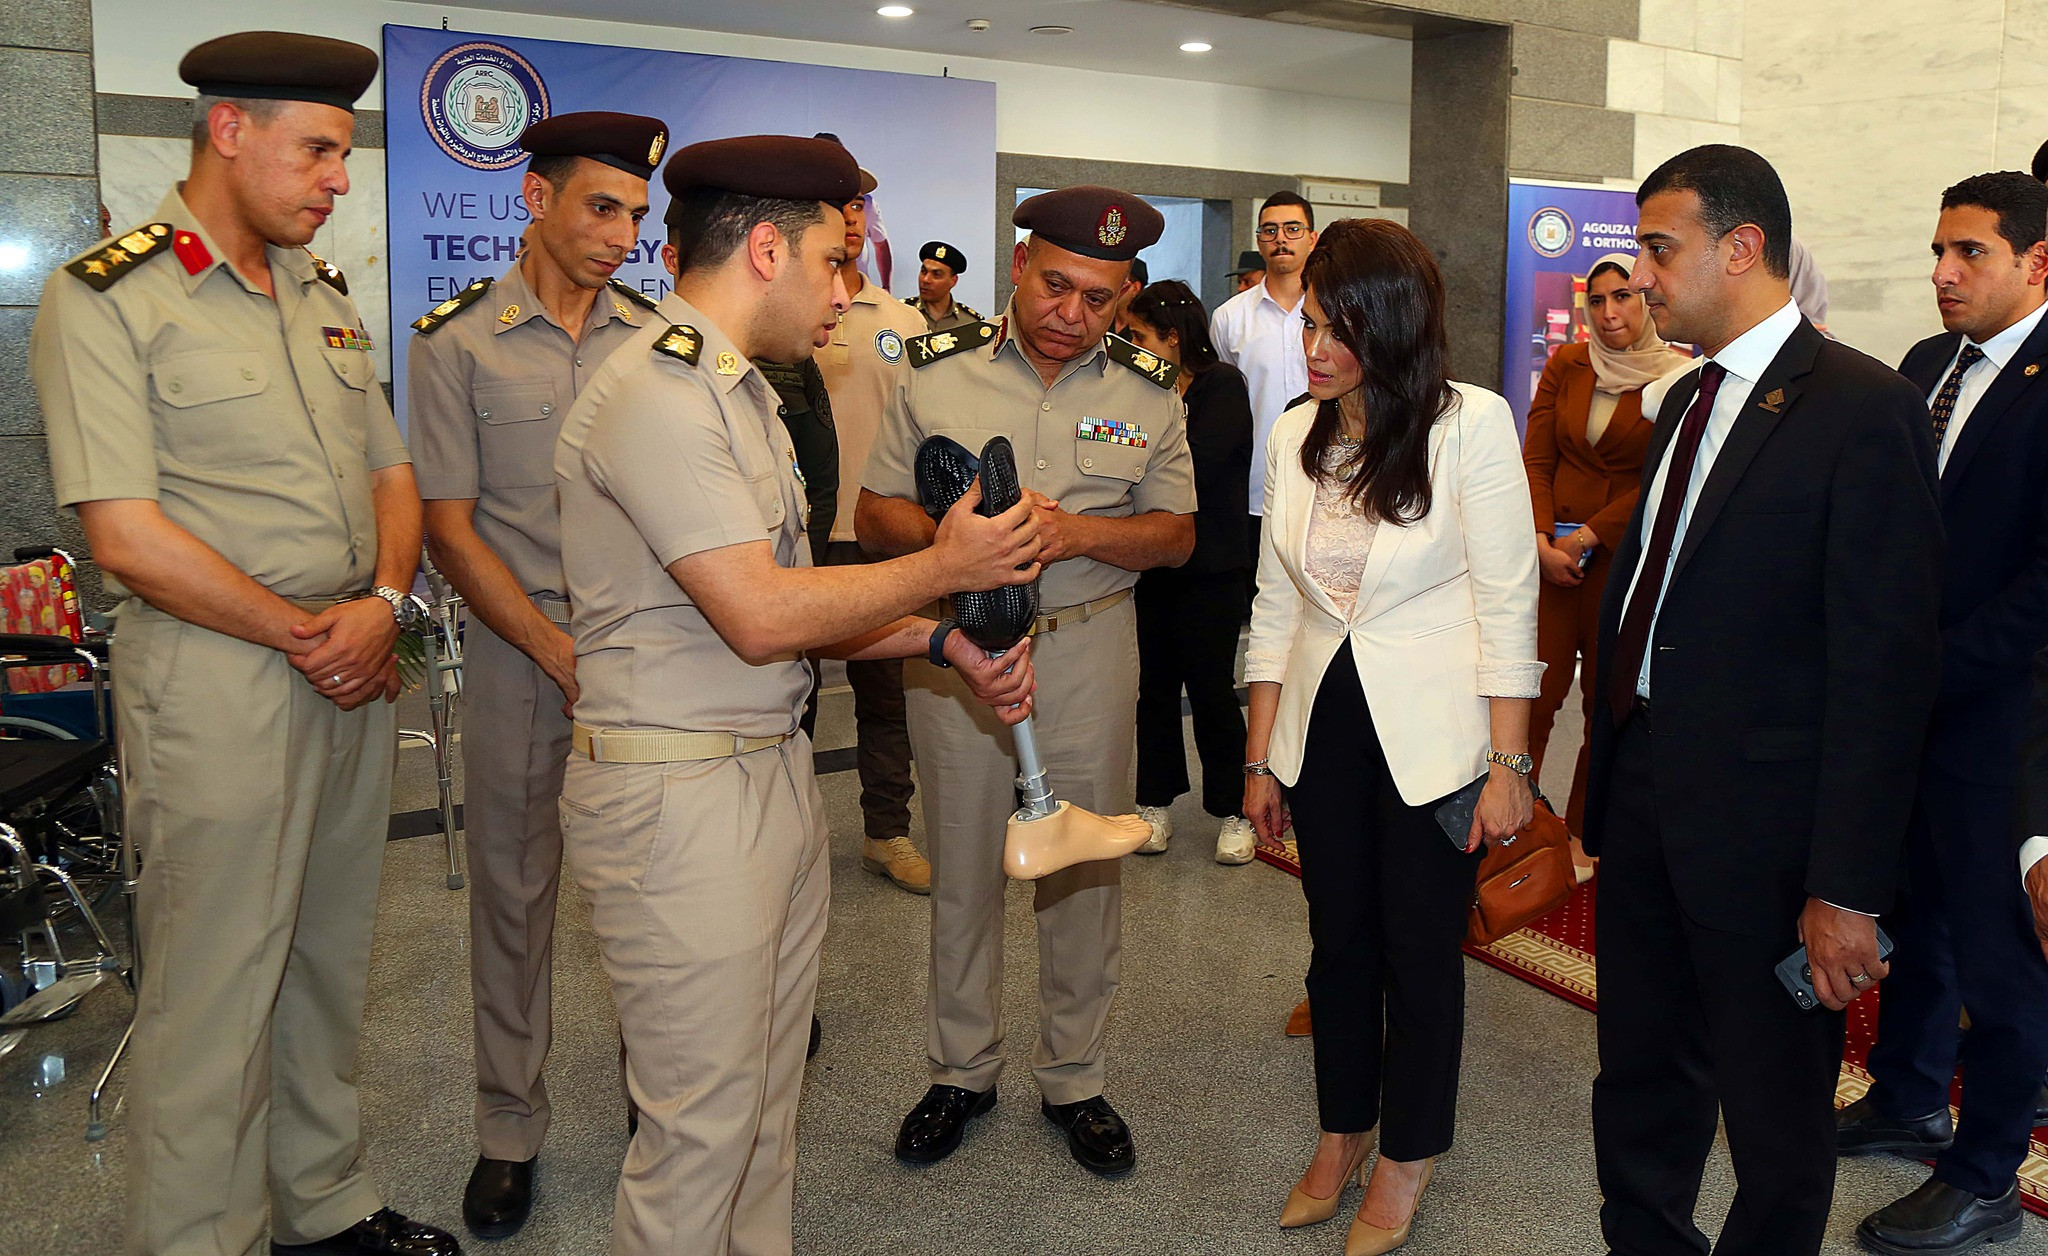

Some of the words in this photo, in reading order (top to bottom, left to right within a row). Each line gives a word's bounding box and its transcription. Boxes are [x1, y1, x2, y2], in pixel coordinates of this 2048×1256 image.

[422, 192, 477, 219] WE
[489, 194, 530, 221] US
[1582, 222, 1632, 235] AGOUZA
[1582, 236, 1592, 247] &
